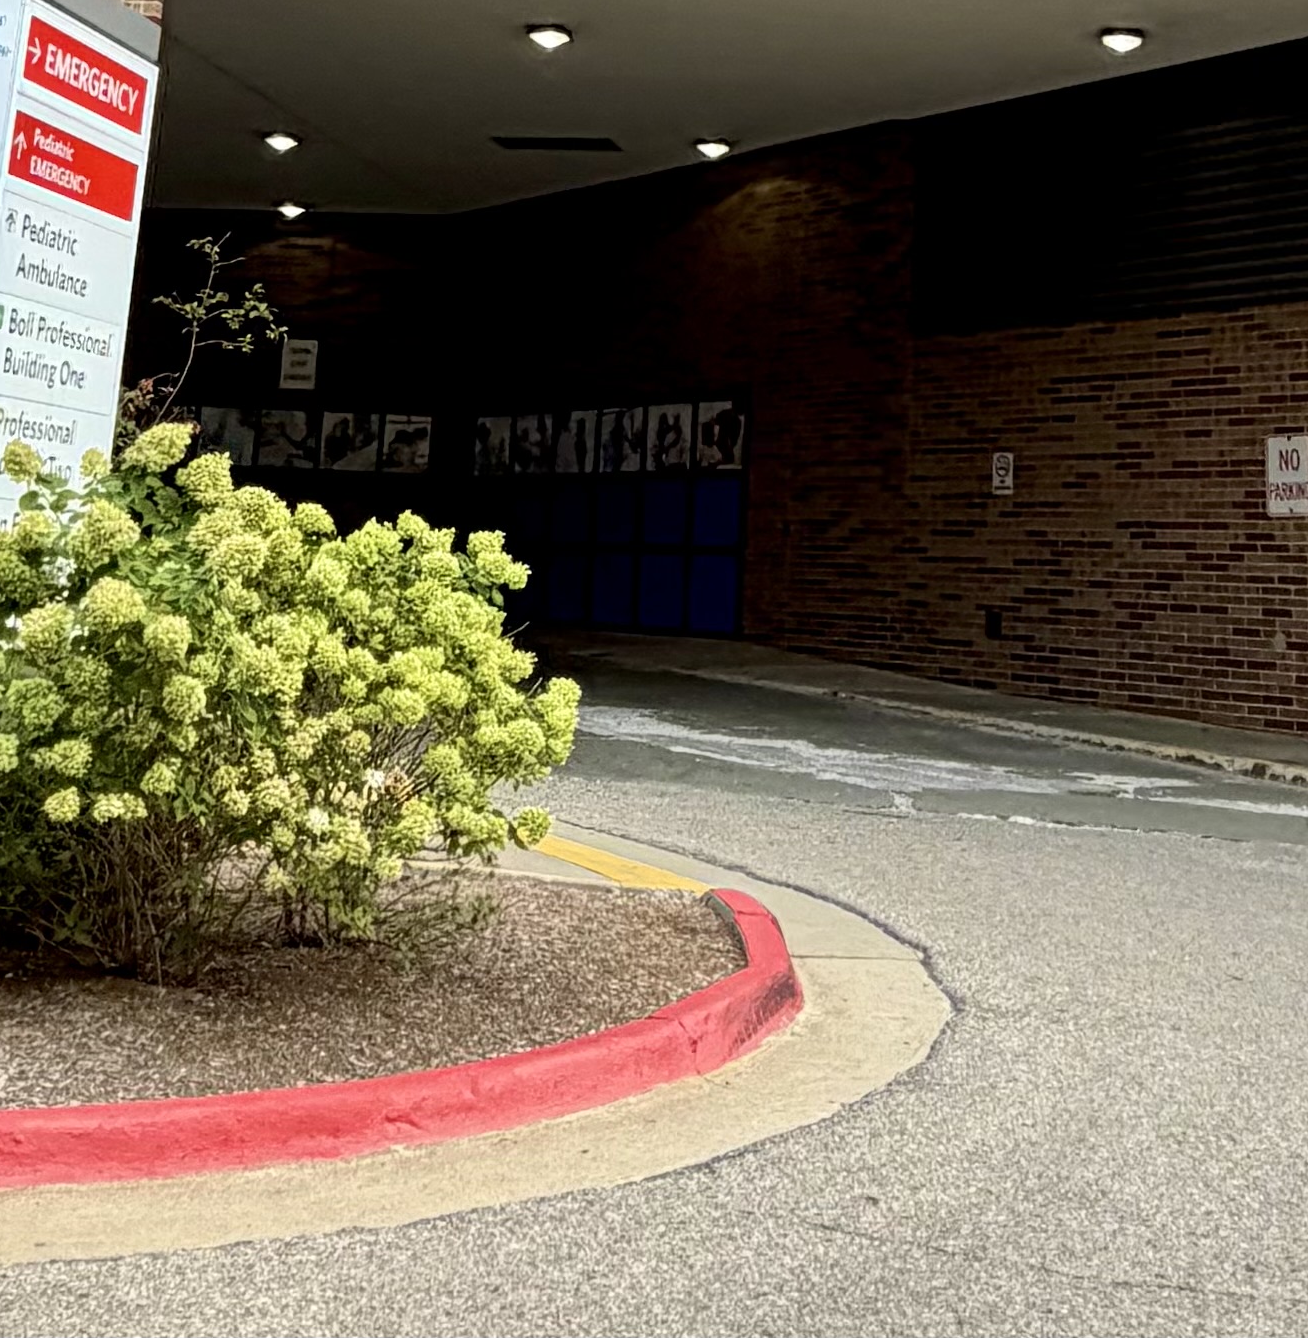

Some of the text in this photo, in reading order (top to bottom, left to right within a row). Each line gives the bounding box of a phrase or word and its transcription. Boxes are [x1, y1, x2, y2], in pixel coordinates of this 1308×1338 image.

[44, 43, 139, 116] EMERGENCY
[33, 127, 75, 162] Pediatric
[30, 155, 91, 195] EMERGENCY
[22, 214, 78, 256] Pediatric
[16, 253, 87, 297] Ambulance
[9, 308, 113, 357] Boll Professional
[3, 347, 85, 389] Building One
[1279, 448, 1300, 471] NO
